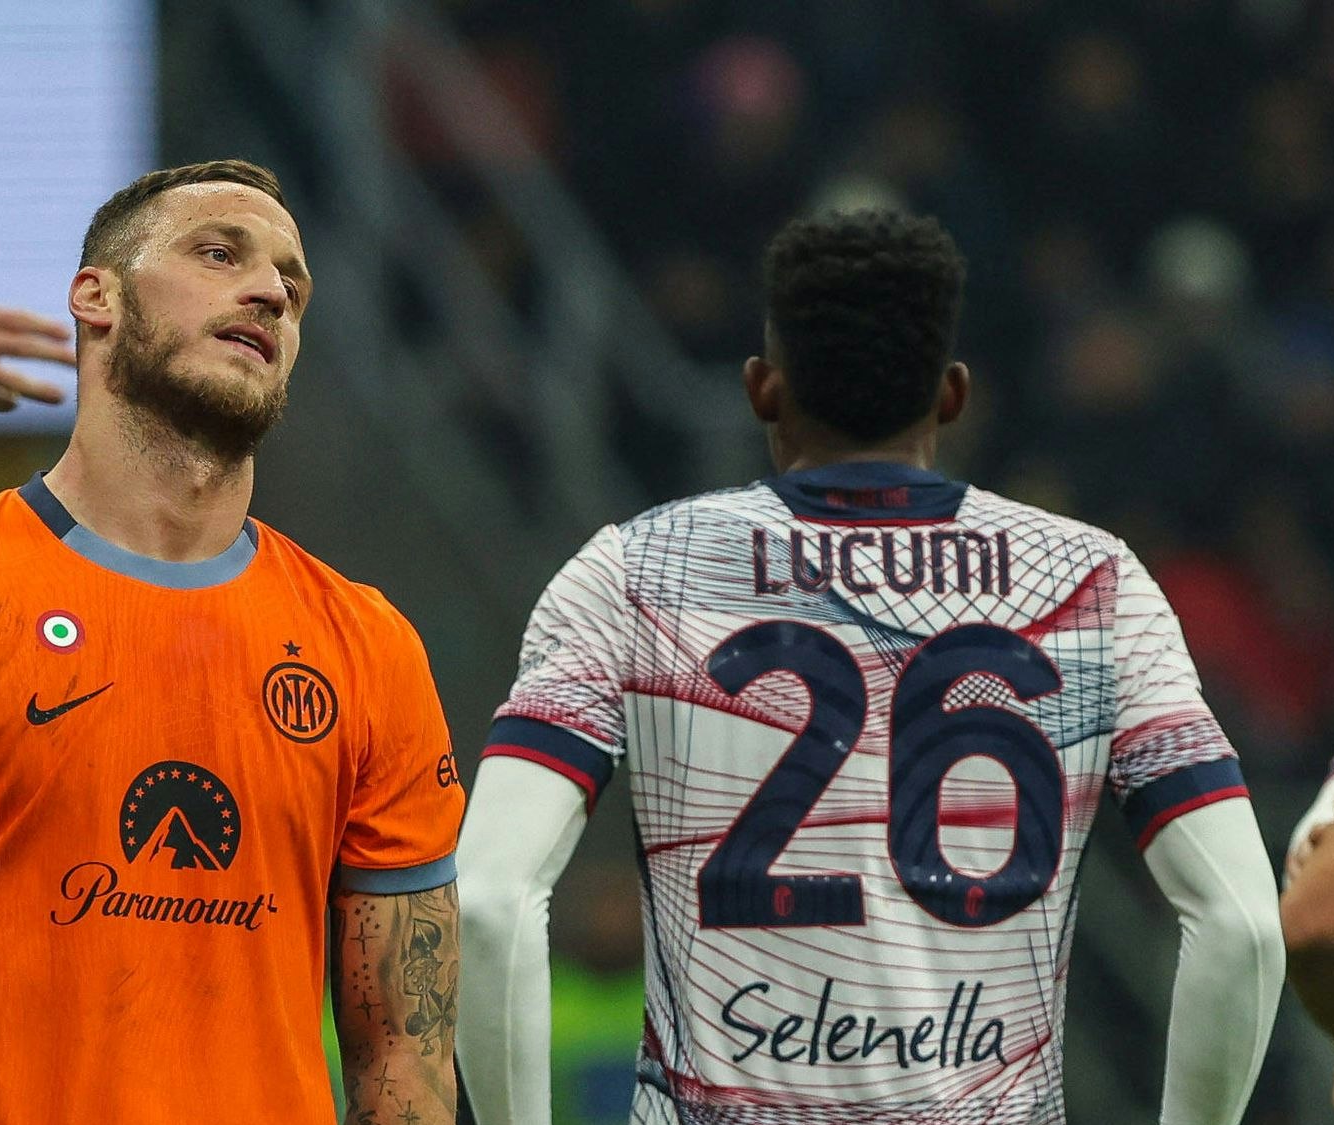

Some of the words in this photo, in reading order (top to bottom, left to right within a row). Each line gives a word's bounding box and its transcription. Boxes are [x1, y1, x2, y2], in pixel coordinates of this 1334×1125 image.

[753, 528, 1012, 597] LUCUMI
[698, 619, 1066, 928] 26
[721, 976, 1008, 1068] Selenella
